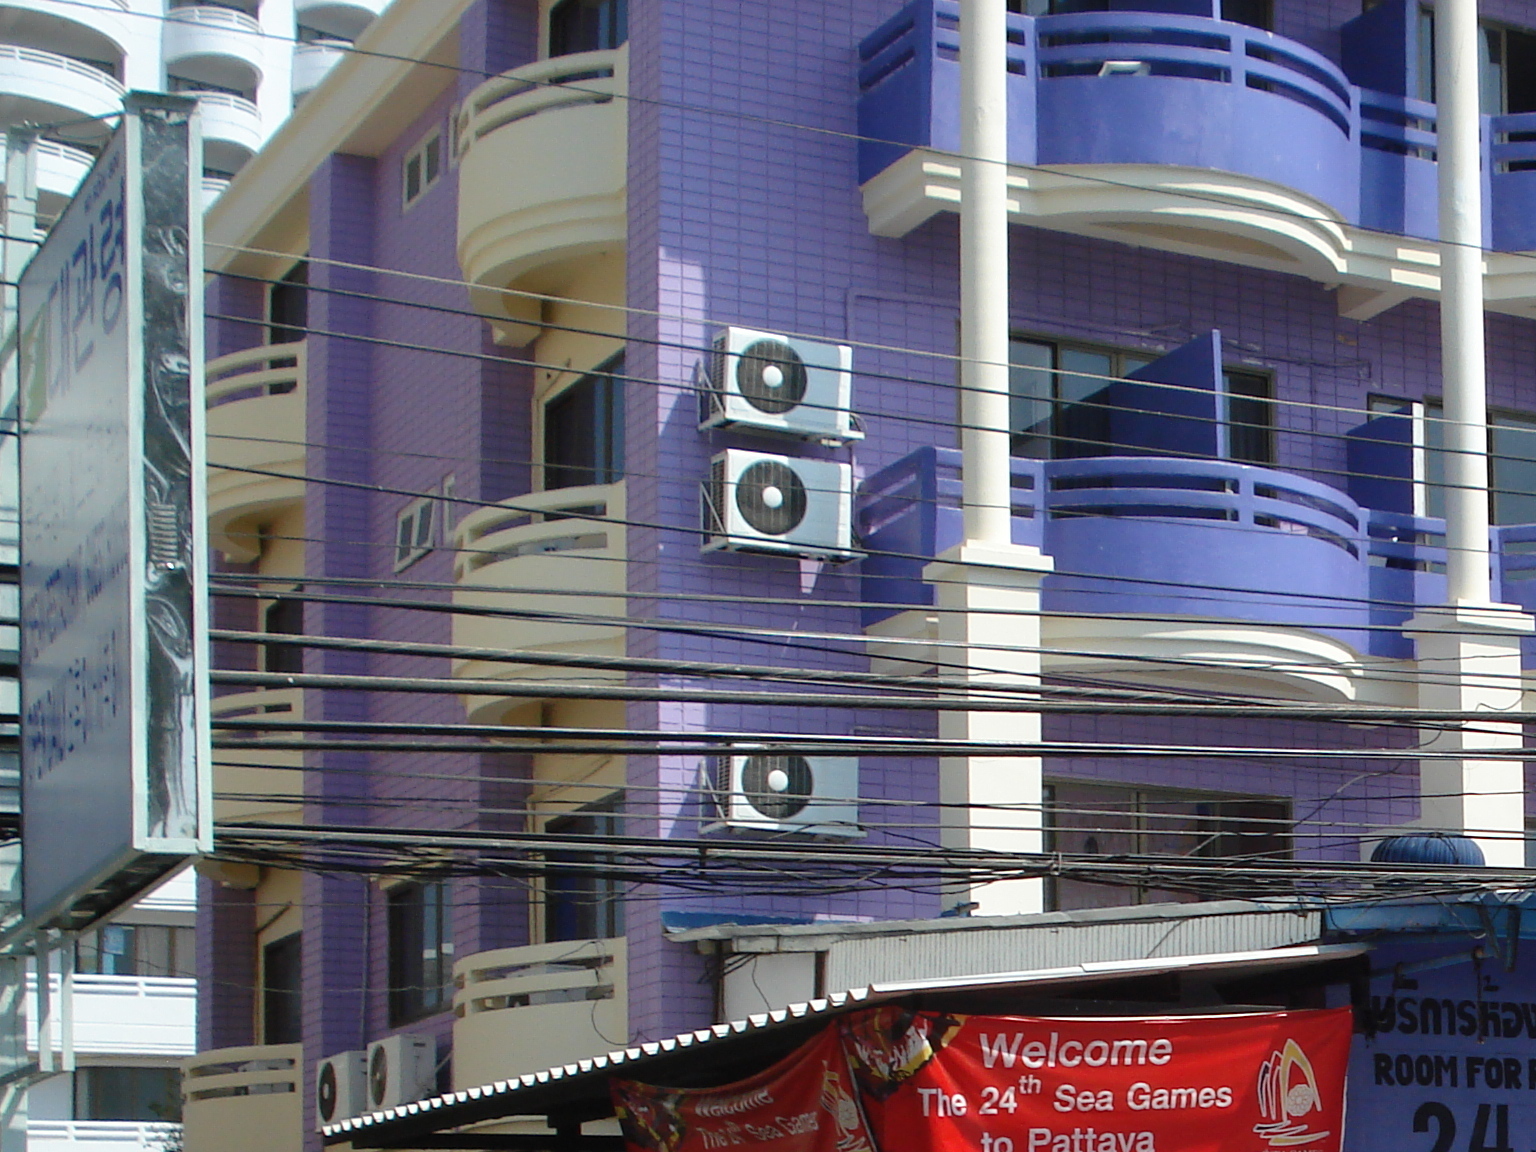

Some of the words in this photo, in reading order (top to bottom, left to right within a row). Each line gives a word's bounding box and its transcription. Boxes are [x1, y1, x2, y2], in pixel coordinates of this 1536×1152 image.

[979, 1032, 1173, 1069] Welcome
[1374, 1053, 1458, 1088] ROOM
[1466, 1056, 1522, 1090] FOR
[917, 1087, 967, 1117] The
[979, 1074, 1042, 1115] 24th
[1053, 1084, 1114, 1112] Sea
[1127, 1082, 1233, 1111] Games
